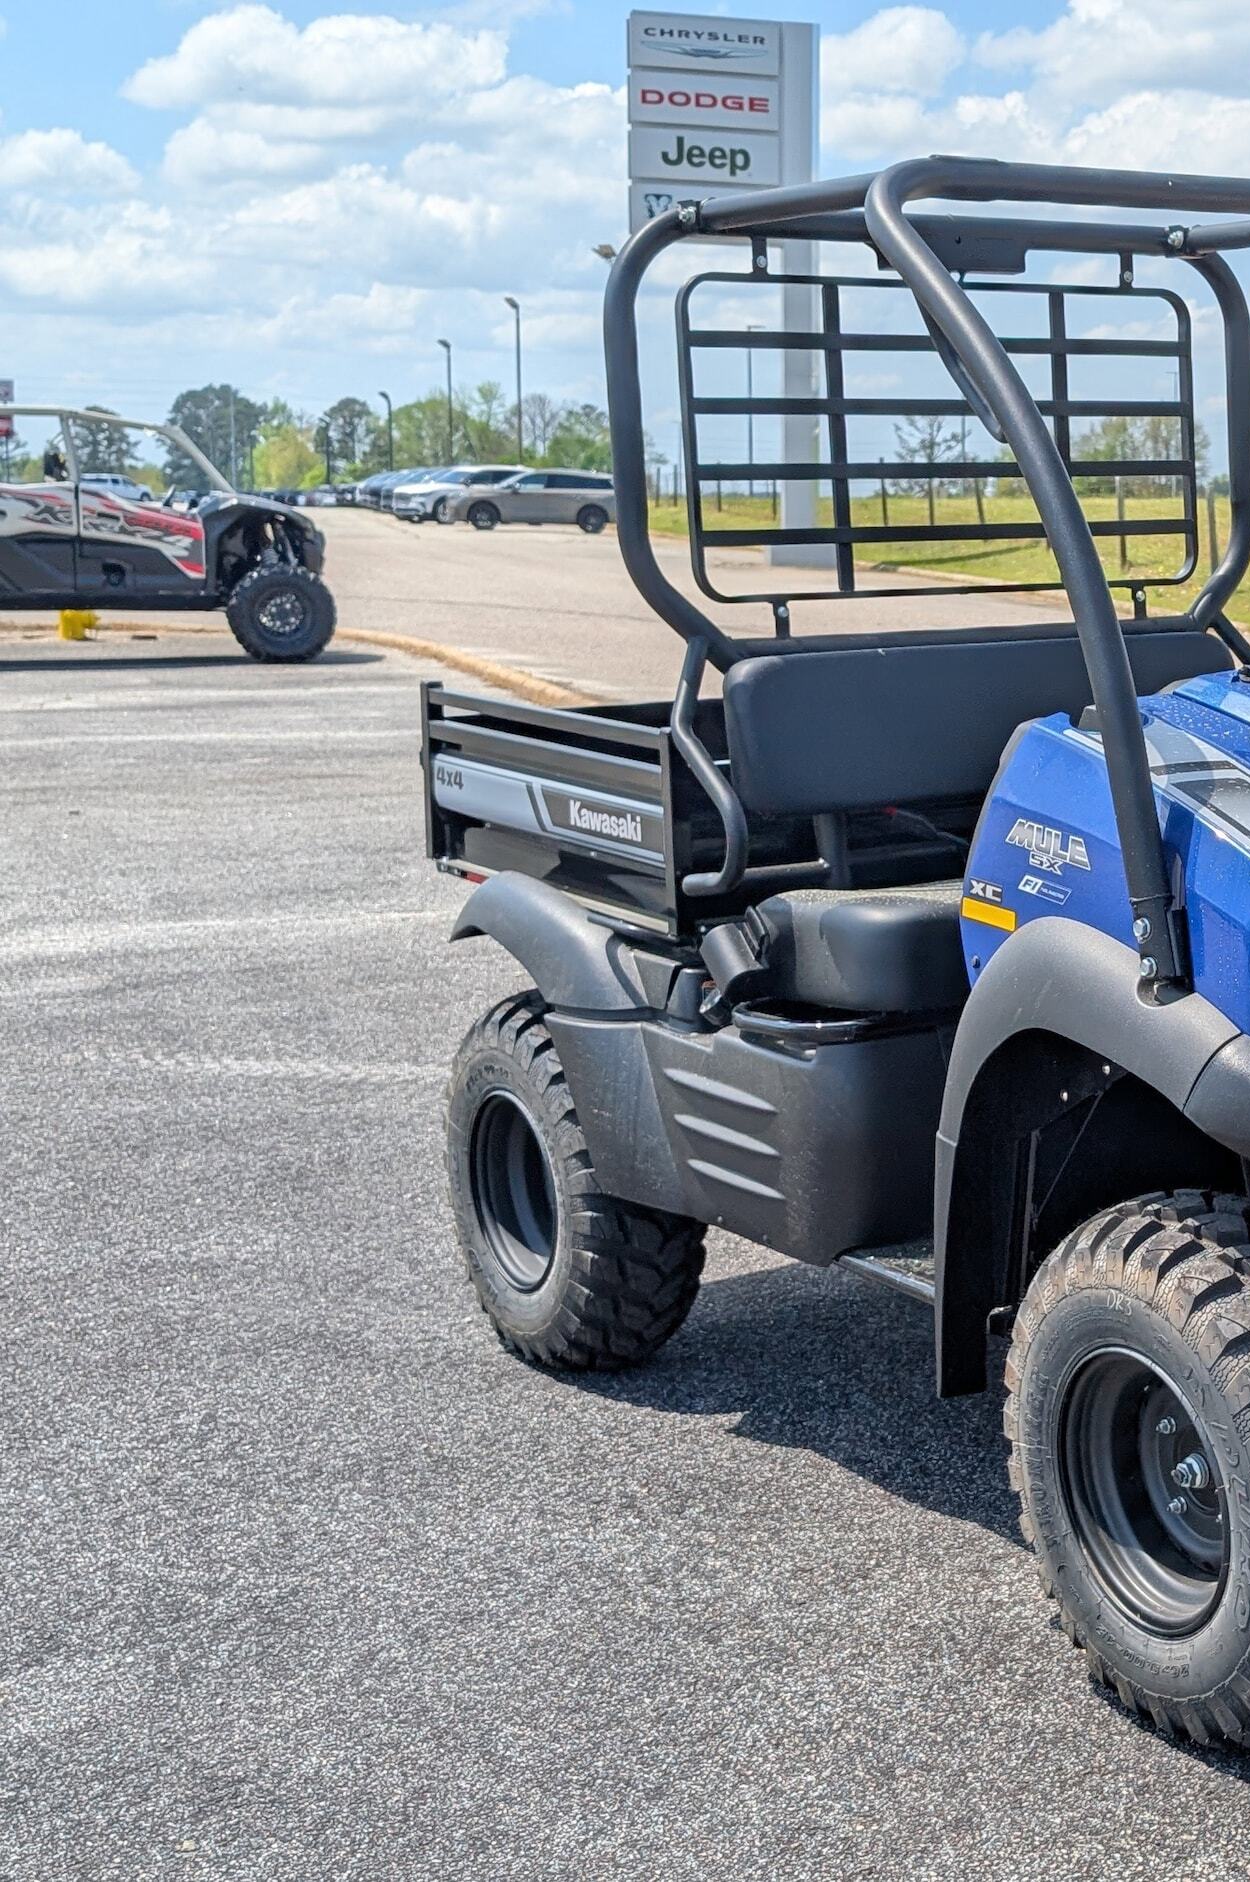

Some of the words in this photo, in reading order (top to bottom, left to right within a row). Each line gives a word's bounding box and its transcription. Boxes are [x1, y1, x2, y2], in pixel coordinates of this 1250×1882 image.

[643, 27, 766, 45] CHRYSLER
[640, 88, 770, 113] DODGE
[661, 135, 751, 176] Jeep
[436, 766, 464, 790] 4x4
[568, 799, 642, 843] Kawasaki
[1005, 818, 1092, 871] MULE
[1028, 851, 1064, 876] SX
[969, 880, 1003, 902] XC
